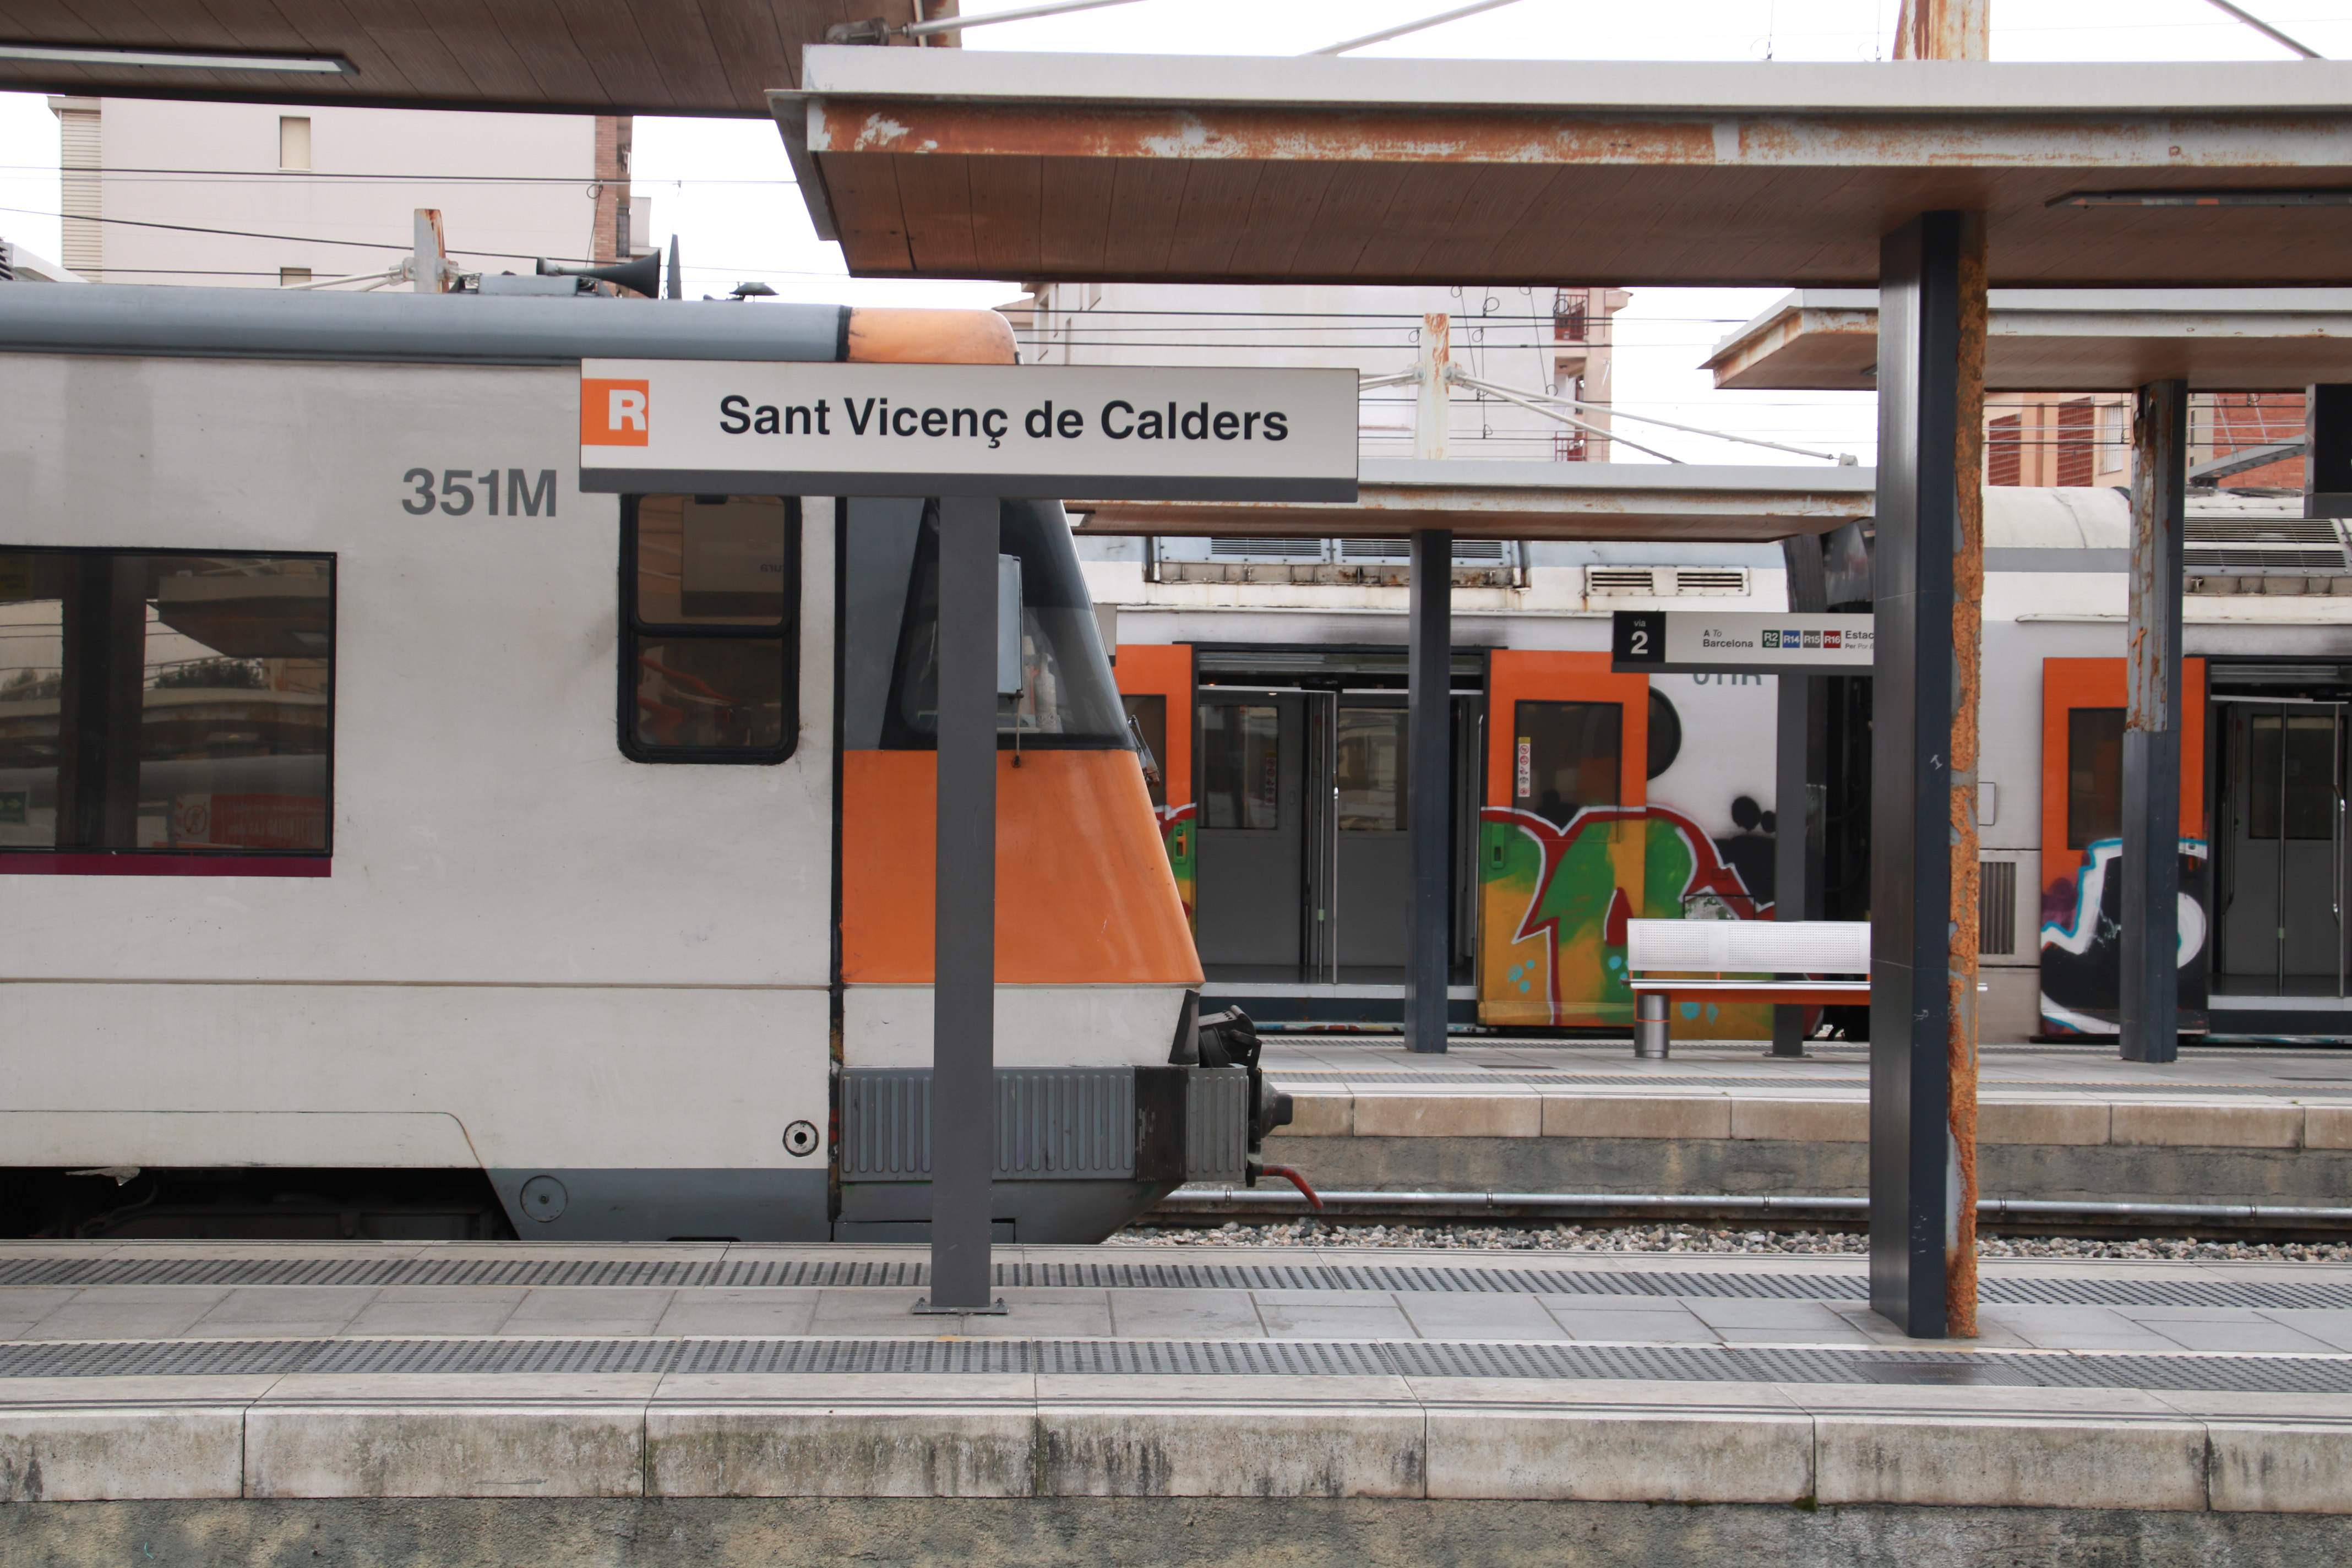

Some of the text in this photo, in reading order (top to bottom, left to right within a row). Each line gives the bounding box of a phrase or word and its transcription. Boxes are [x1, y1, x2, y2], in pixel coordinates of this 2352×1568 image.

[609, 391, 646, 431] R
[720, 395, 1288, 449] Sant Vicenç de Calders
[402, 467, 557, 517] 351M
[1712, 629, 1723, 638] To
[1764, 632, 1778, 641] R2
[1845, 630, 1874, 639] Estac
[1631, 630, 1648, 654] 2
[1702, 639, 1754, 648] Barcelona
[1783, 635, 1799, 644] R14
[1804, 635, 1820, 644] R15
[1824, 635, 1841, 644] R16
